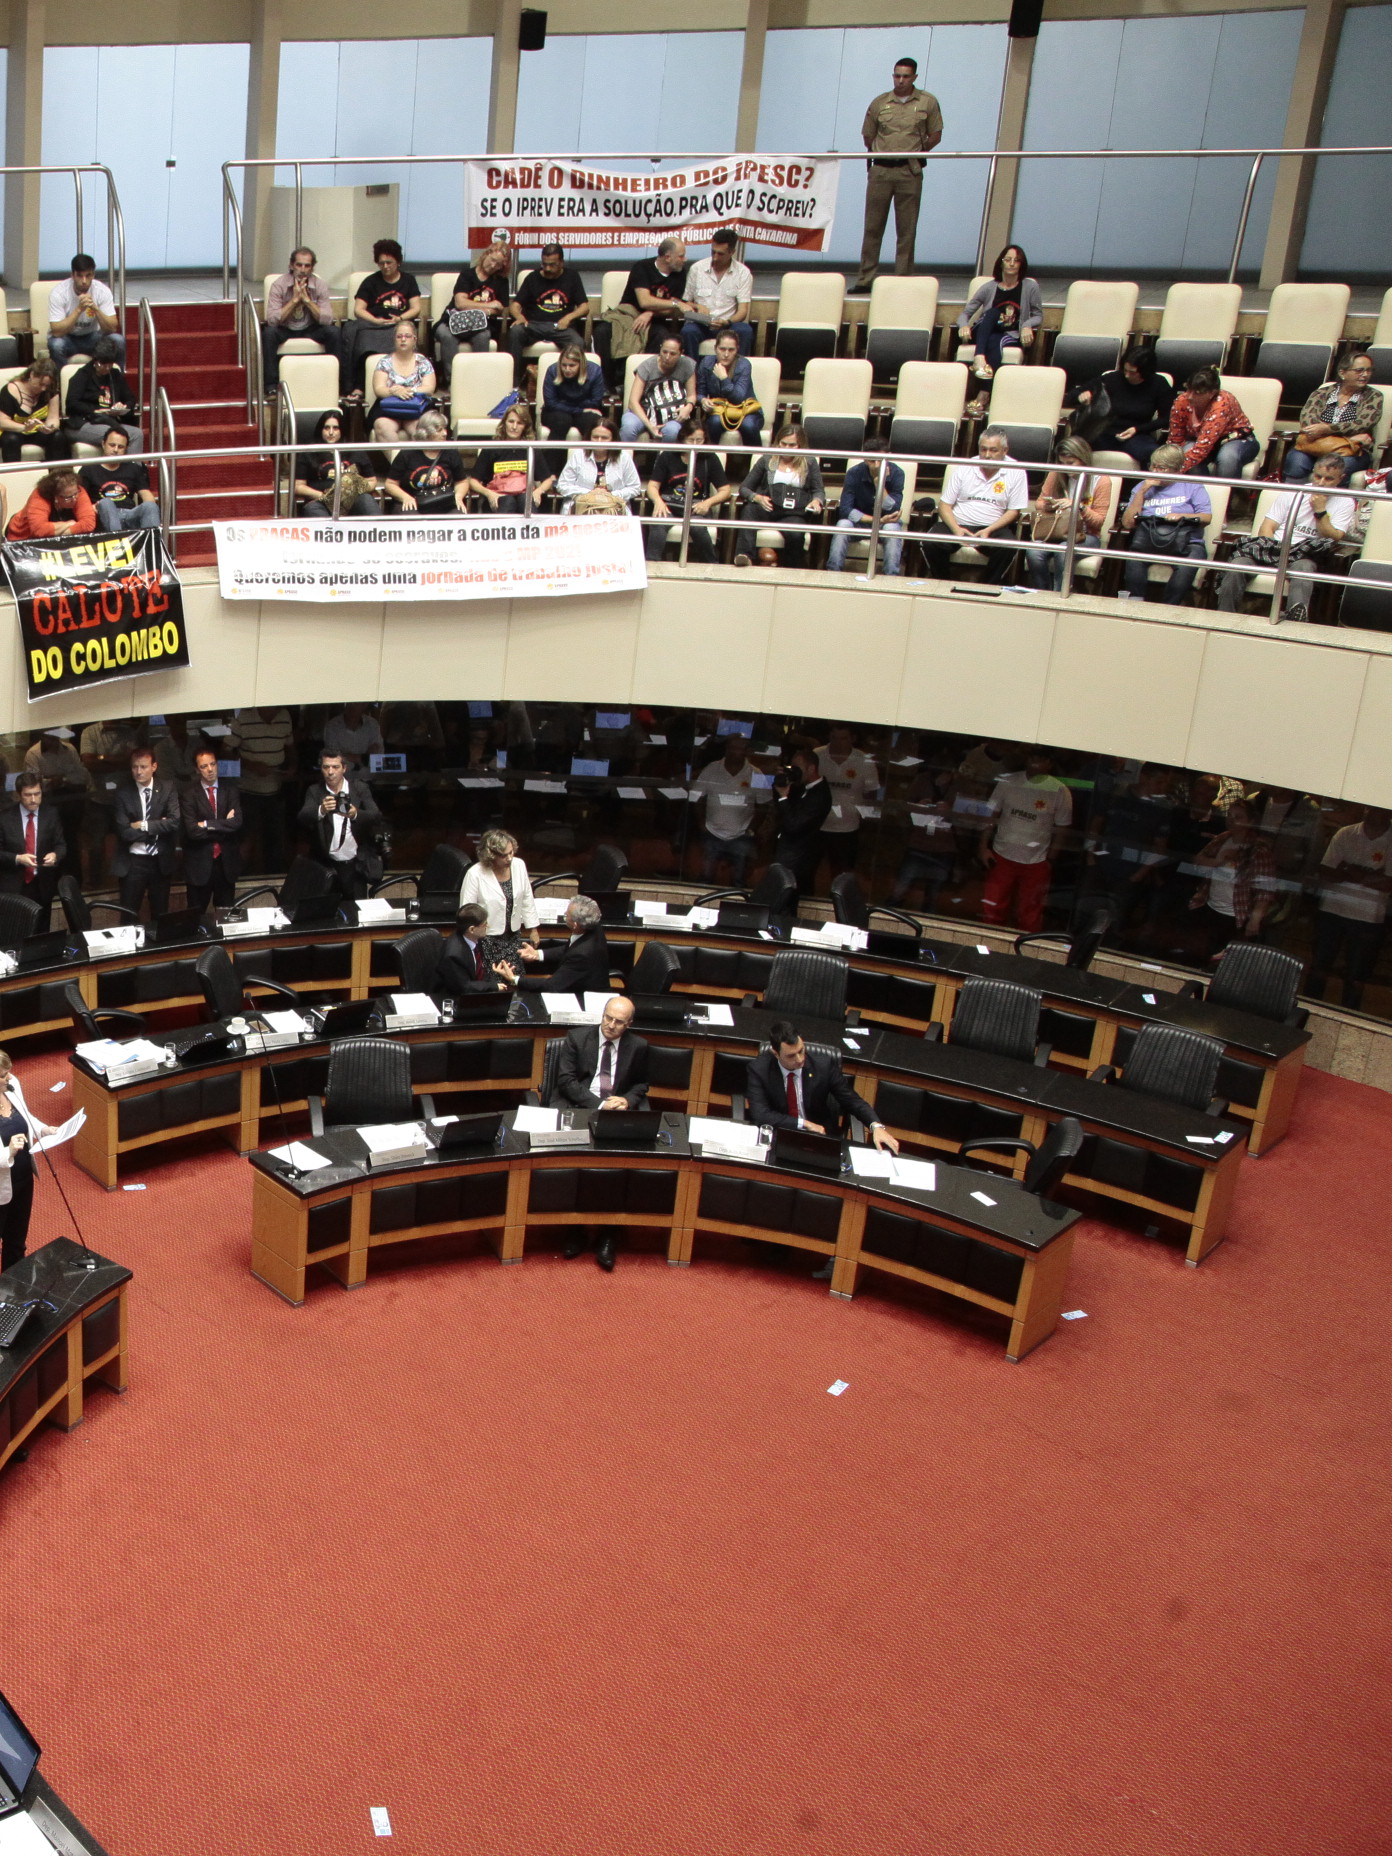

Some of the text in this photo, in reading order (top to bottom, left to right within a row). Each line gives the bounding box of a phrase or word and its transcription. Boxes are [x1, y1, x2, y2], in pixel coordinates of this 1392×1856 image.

[487, 160, 815, 193] CADÊ O DINHEIRO DO IPESC?
[480, 198, 497, 218] SE
[502, 198, 512, 217] O
[516, 197, 553, 217] IPREV
[558, 198, 585, 217] ERA
[589, 198, 599, 217] A
[679, 195, 708, 216] PRA
[713, 188, 743, 216] QUE
[746, 189, 755, 209] O
[757, 192, 816, 219] SCPREV?
[540, 232, 557, 245] DOS
[558, 232, 613, 245] SERVIDORES
[614, 232, 619, 245] E
[756, 228, 798, 245] CATARINA
[1144, 496, 1187, 507] MULHERES
[1155, 506, 1172, 515] QUE
[226, 527, 245, 541] Os
[314, 527, 343, 543] não
[348, 528, 402, 544] podem
[406, 528, 454, 544] pagar
[458, 529, 467, 541] a
[471, 526, 516, 541] conta
[520, 525, 540, 539] da
[544, 522, 568, 538] má
[40, 538, 136, 581] #LEVEI
[234, 569, 315, 585] Queremos
[319, 572, 378, 586] apenas
[382, 571, 417, 584] uma
[420, 569, 484, 585] jornada
[488, 567, 508, 582] de
[33, 569, 169, 635] CALOTE
[31, 621, 179, 683] DO COLOMBO
